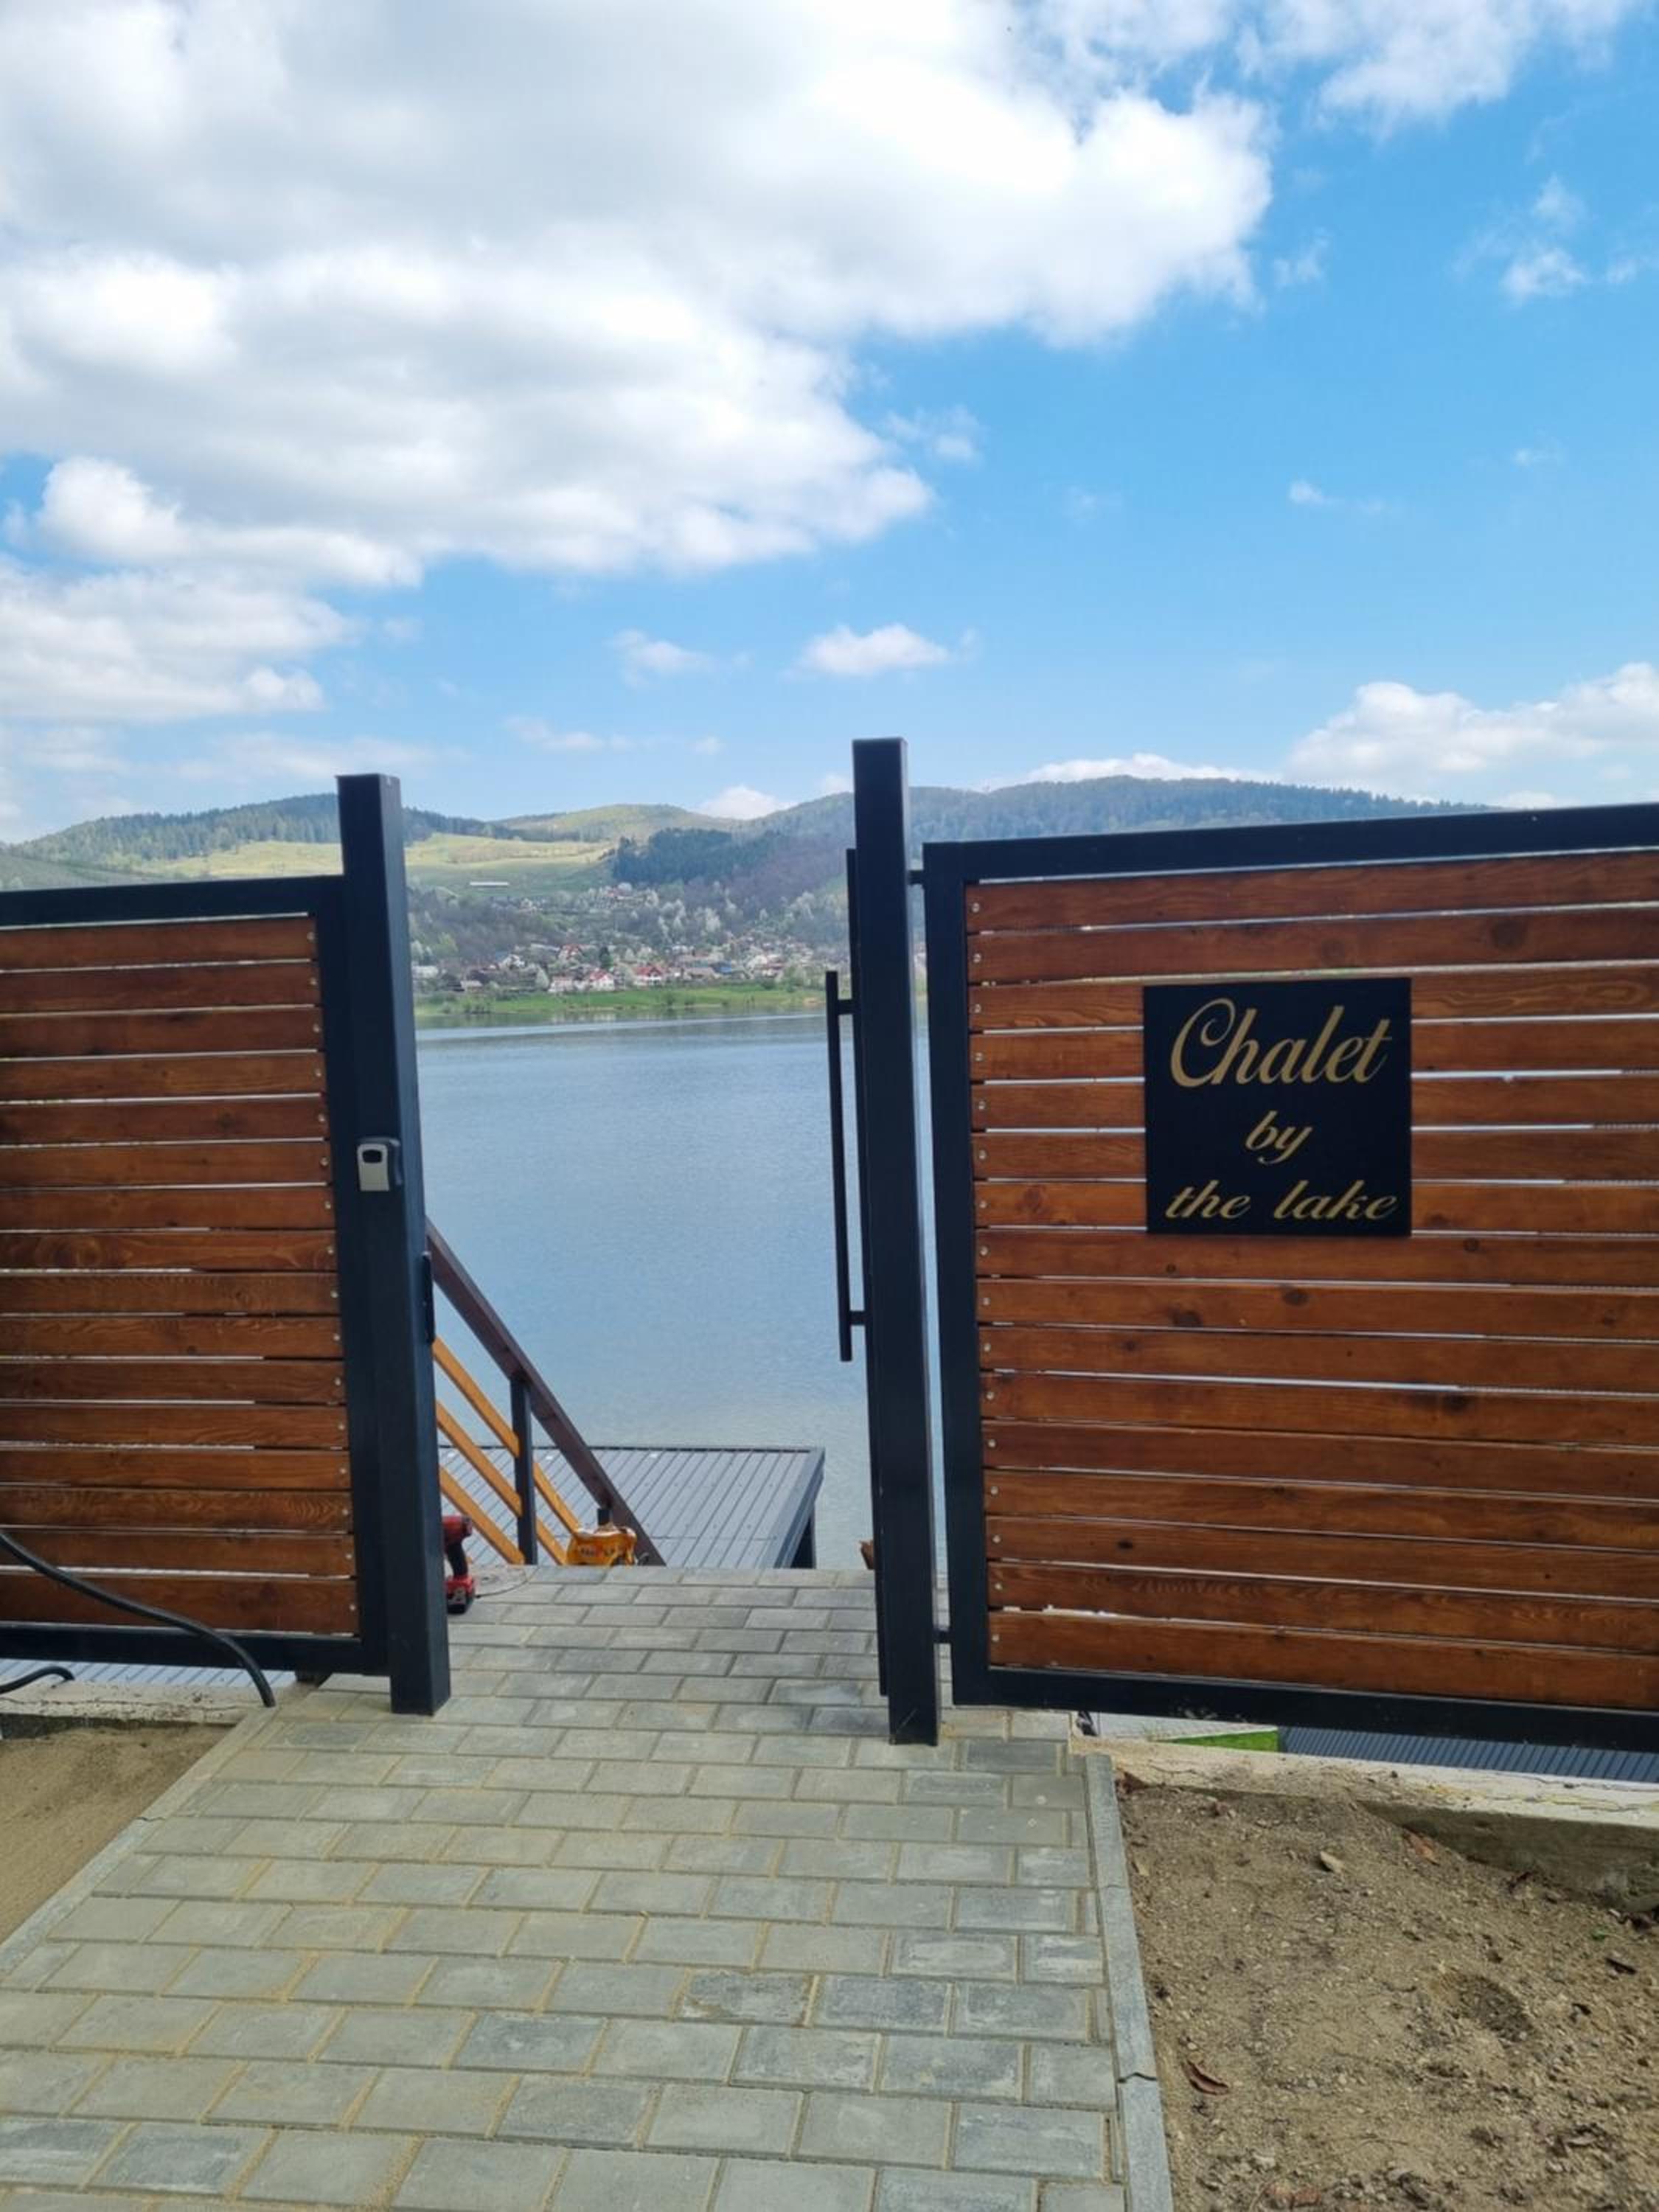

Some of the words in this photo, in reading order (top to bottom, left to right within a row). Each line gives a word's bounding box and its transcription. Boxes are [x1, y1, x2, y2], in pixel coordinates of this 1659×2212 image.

[1170, 998, 1392, 1087] Chalet
[1245, 1110, 1312, 1164] by
[1166, 1180, 1251, 1219] the
[1273, 1180, 1397, 1220] lake
